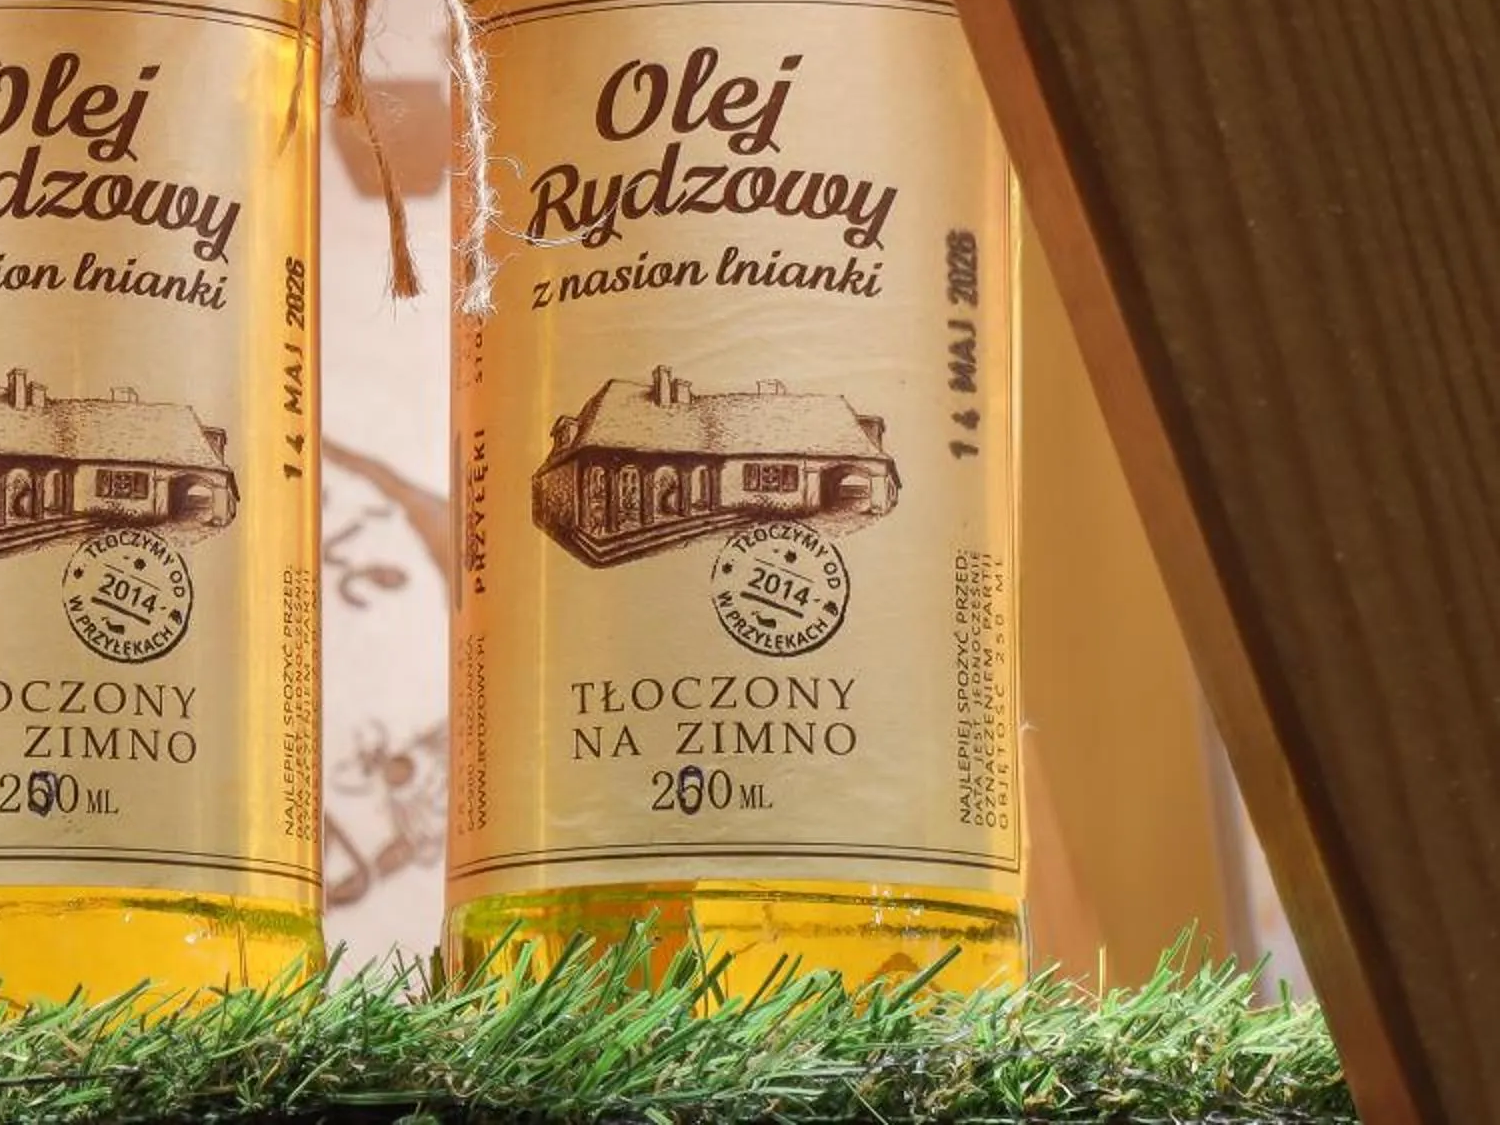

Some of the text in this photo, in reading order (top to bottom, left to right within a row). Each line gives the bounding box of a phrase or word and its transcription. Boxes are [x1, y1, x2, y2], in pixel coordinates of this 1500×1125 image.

[595, 46, 804, 155] Olej
[527, 143, 899, 251] Rydzowy
[73, 253, 228, 311] lnianki
[285, 256, 305, 332] 2026
[531, 247, 884, 310] z nasion lnianki
[283, 342, 304, 416] MAJ
[947, 319, 978, 394] MAJ
[84, 531, 185, 598] TŁOCZYMY OD
[732, 525, 841, 589] TŁOCZYMY OD
[748, 567, 810, 606] 2014
[954, 549, 969, 624] PRZED:
[69, 595, 83, 612] W
[98, 573, 157, 613] 2014
[717, 591, 733, 608] W
[571, 676, 856, 715] TŁOCZONY
[24, 725, 198, 764] ZIMNO
[571, 721, 858, 760] NA ZIMNO
[972, 720, 983, 763] JEST
[982, 648, 996, 828] OZNACZENIEM
[86, 788, 119, 814] ML
[283, 733, 295, 836] NAJLEPIEJ
[739, 784, 773, 809] ML
[956, 720, 971, 825] NAJLEPIEJ
[972, 775, 984, 827] DATA
